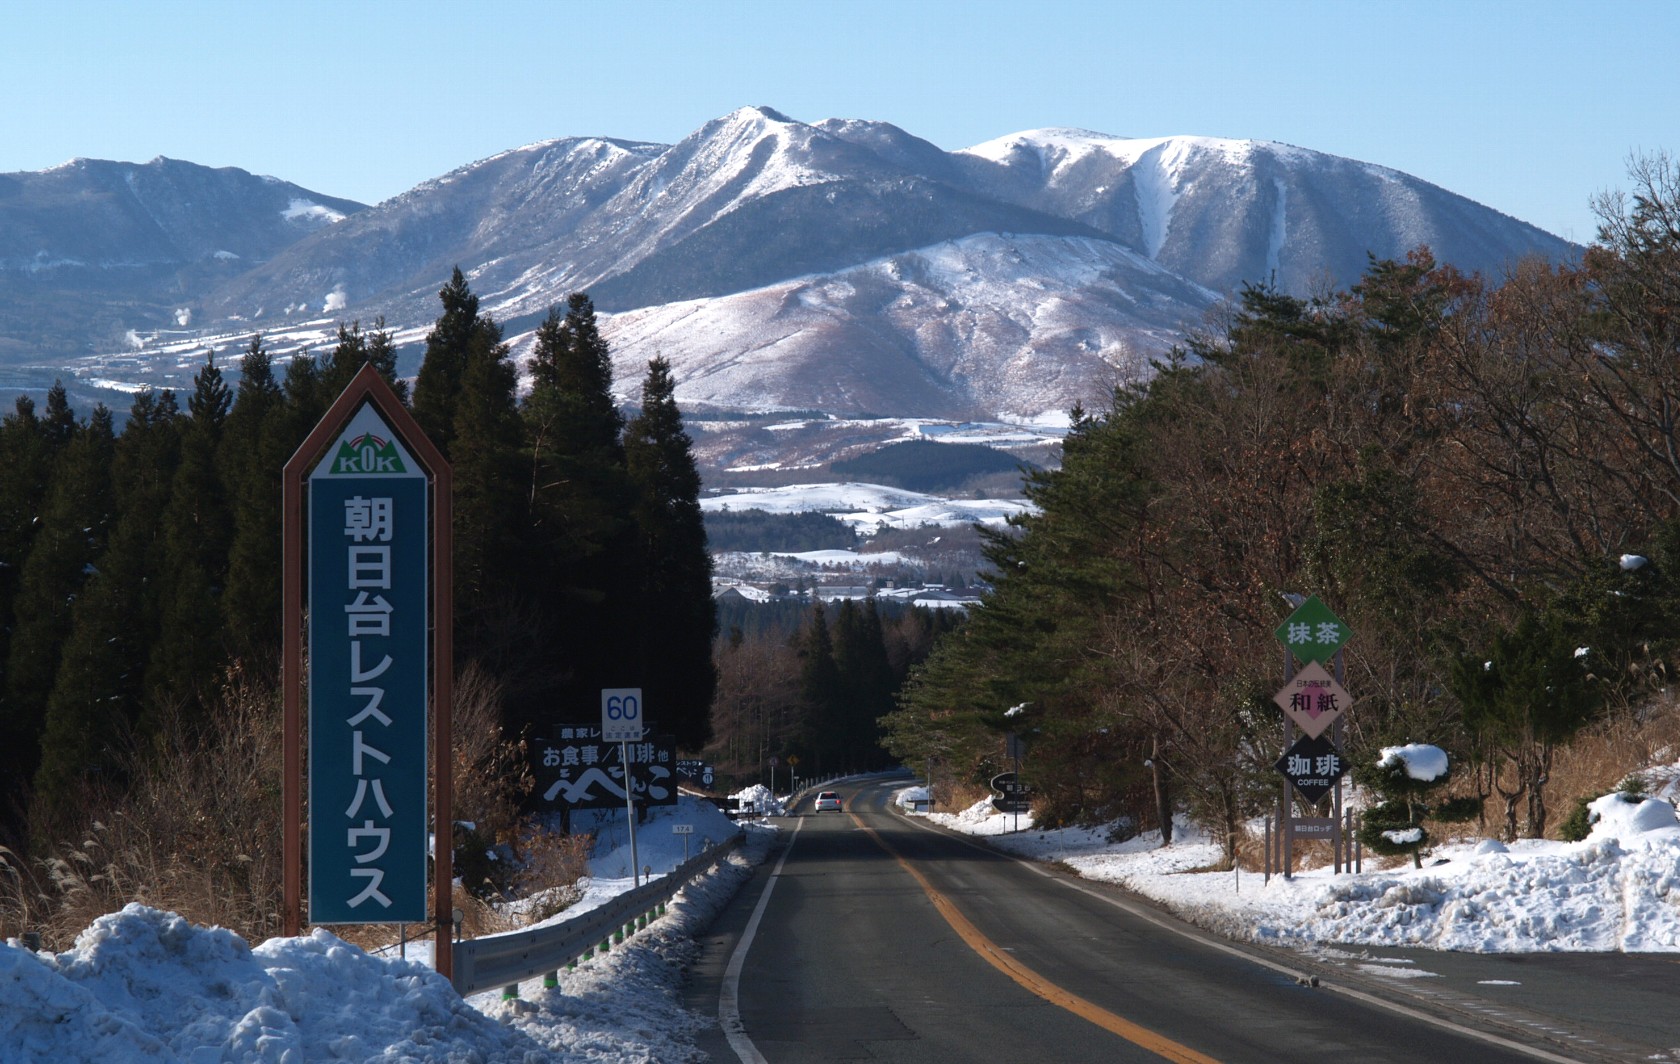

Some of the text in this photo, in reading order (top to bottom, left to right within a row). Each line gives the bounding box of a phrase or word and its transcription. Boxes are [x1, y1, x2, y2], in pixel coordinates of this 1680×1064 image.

[339, 445, 397, 472] KOK
[1287, 621, 1340, 645] 抹茶
[344, 496, 394, 909] 朝日台レストハウス
[607, 696, 637, 720] 60
[1289, 692, 1339, 712] 和紙
[1287, 754, 1340, 776] 珈琲
[1298, 779, 1329, 787] COFFEE
